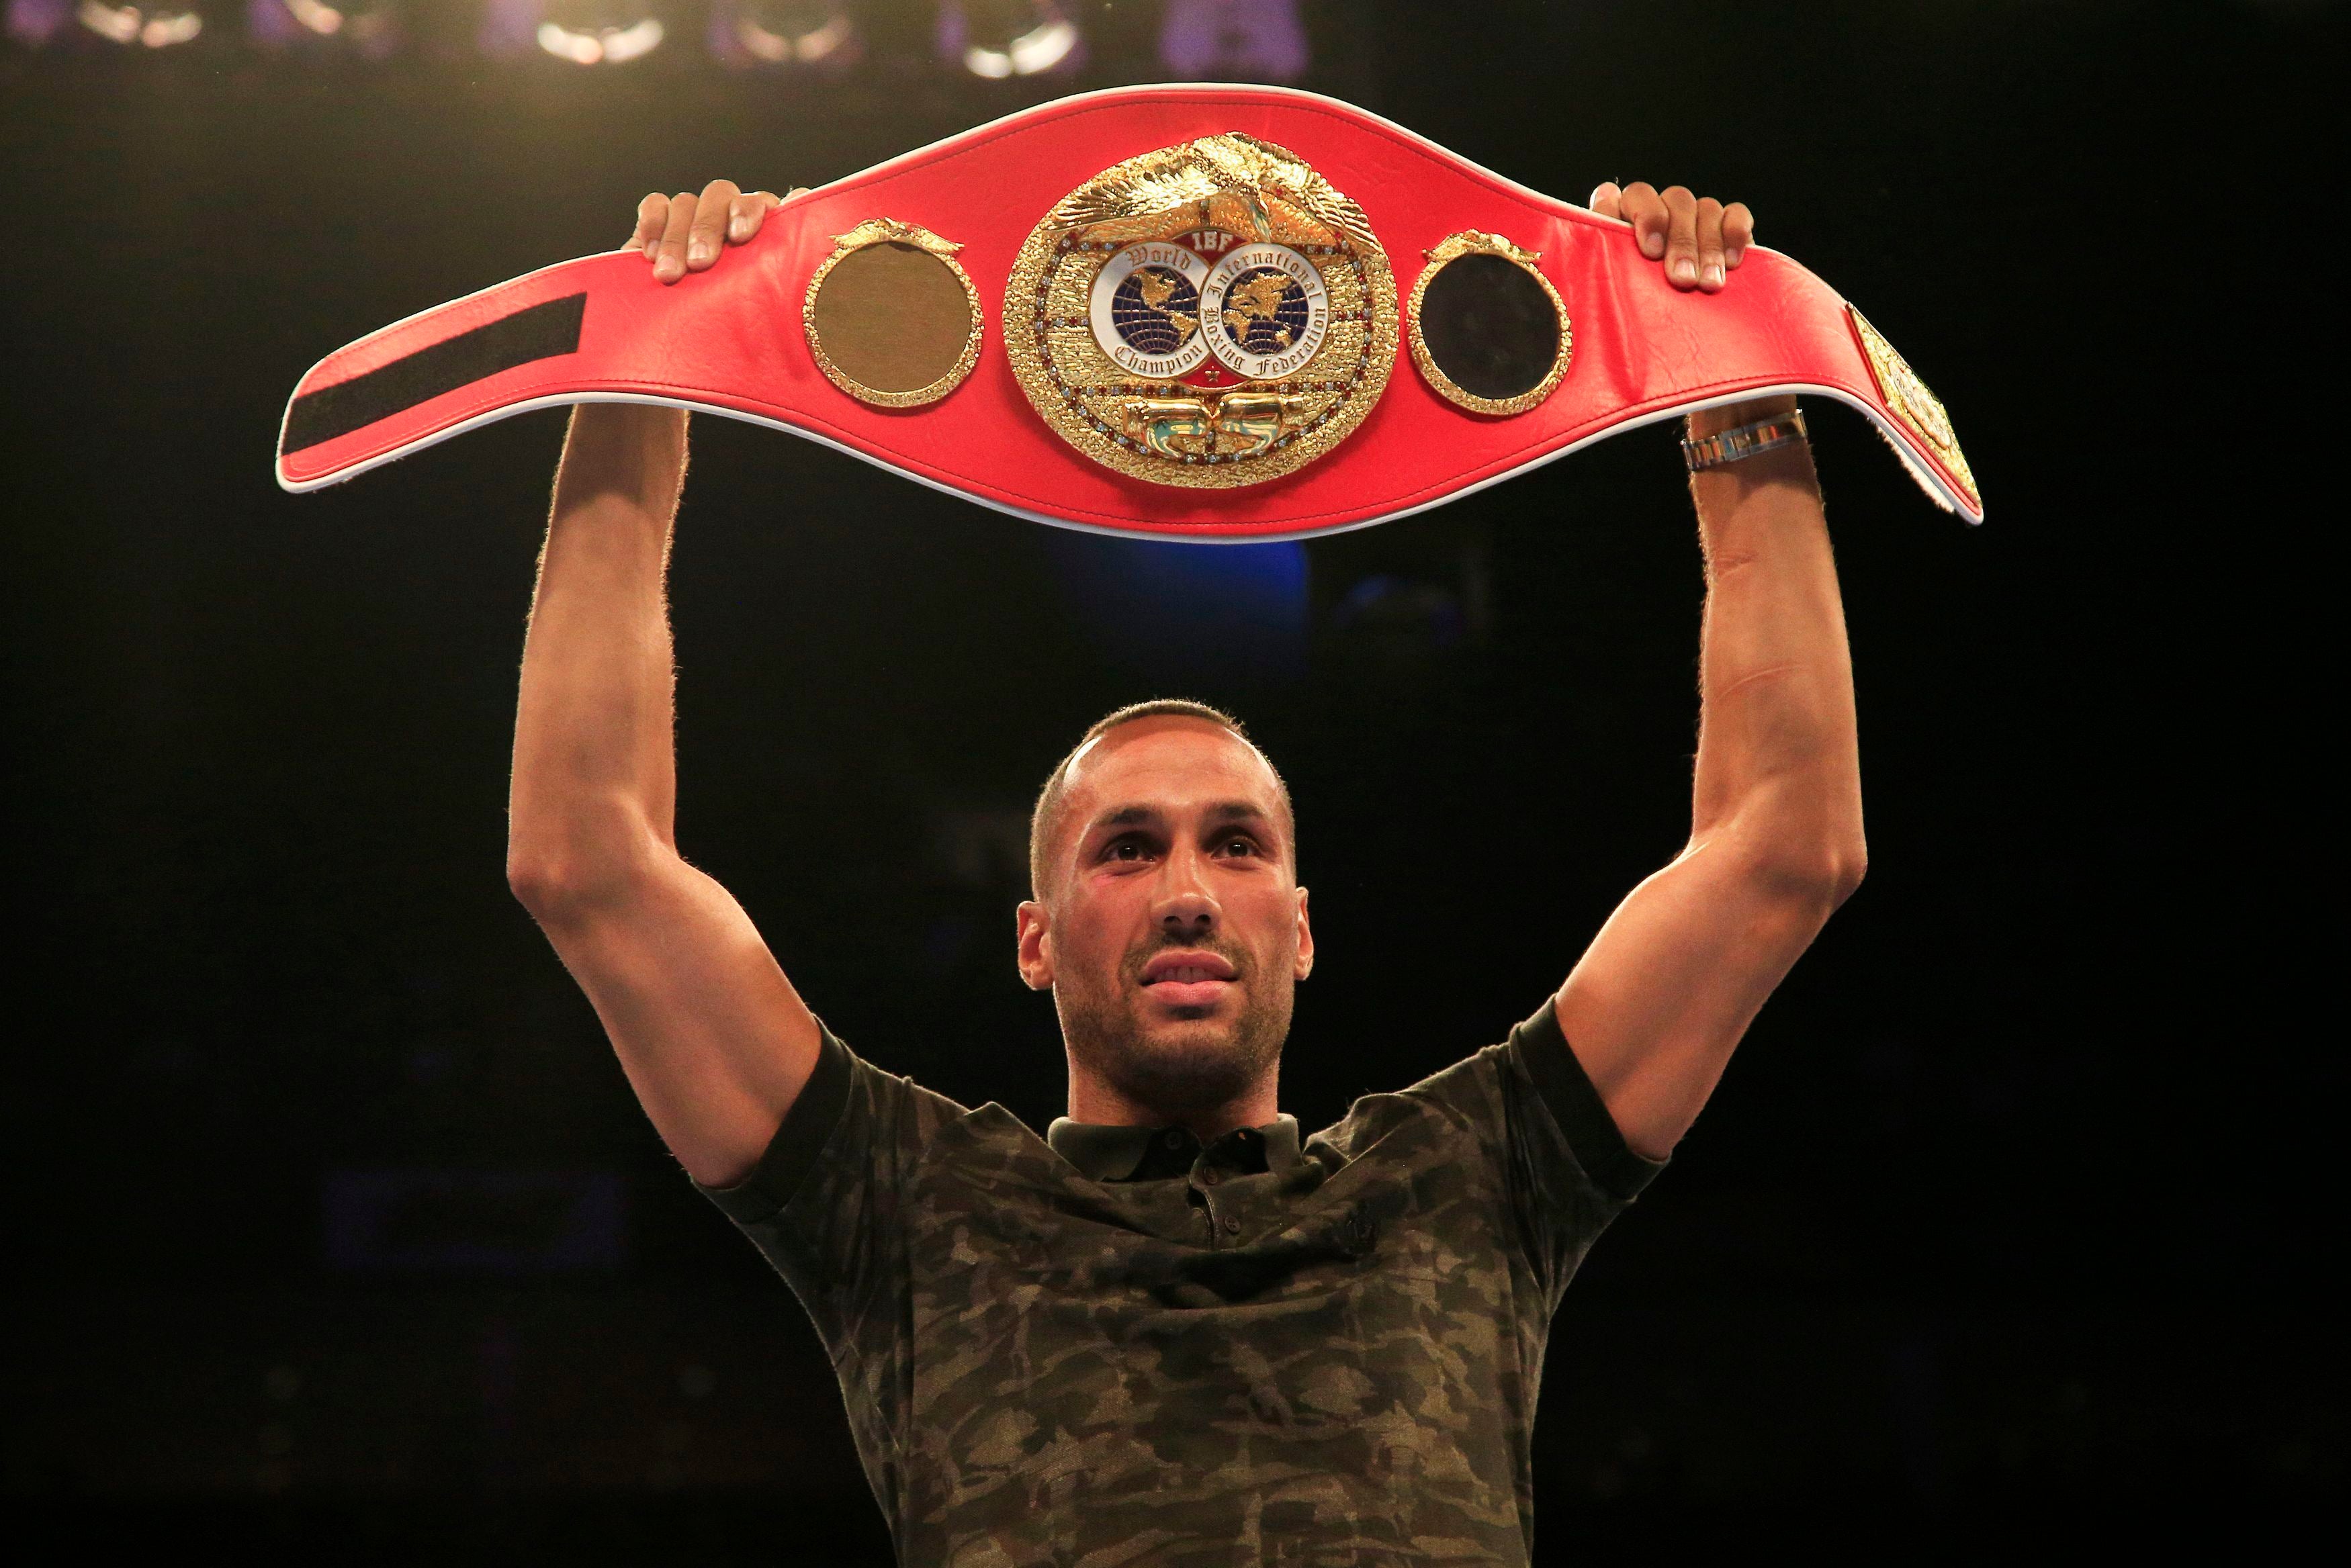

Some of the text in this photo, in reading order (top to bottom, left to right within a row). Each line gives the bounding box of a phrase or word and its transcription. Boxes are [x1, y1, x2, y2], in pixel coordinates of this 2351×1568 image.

[1192, 232, 1233, 252] IBF
[1125, 247, 1191, 271] World
[1207, 252, 1323, 299] International
[1202, 306, 1326, 375] Boxing Federation
[1114, 343, 1203, 374] Champion
